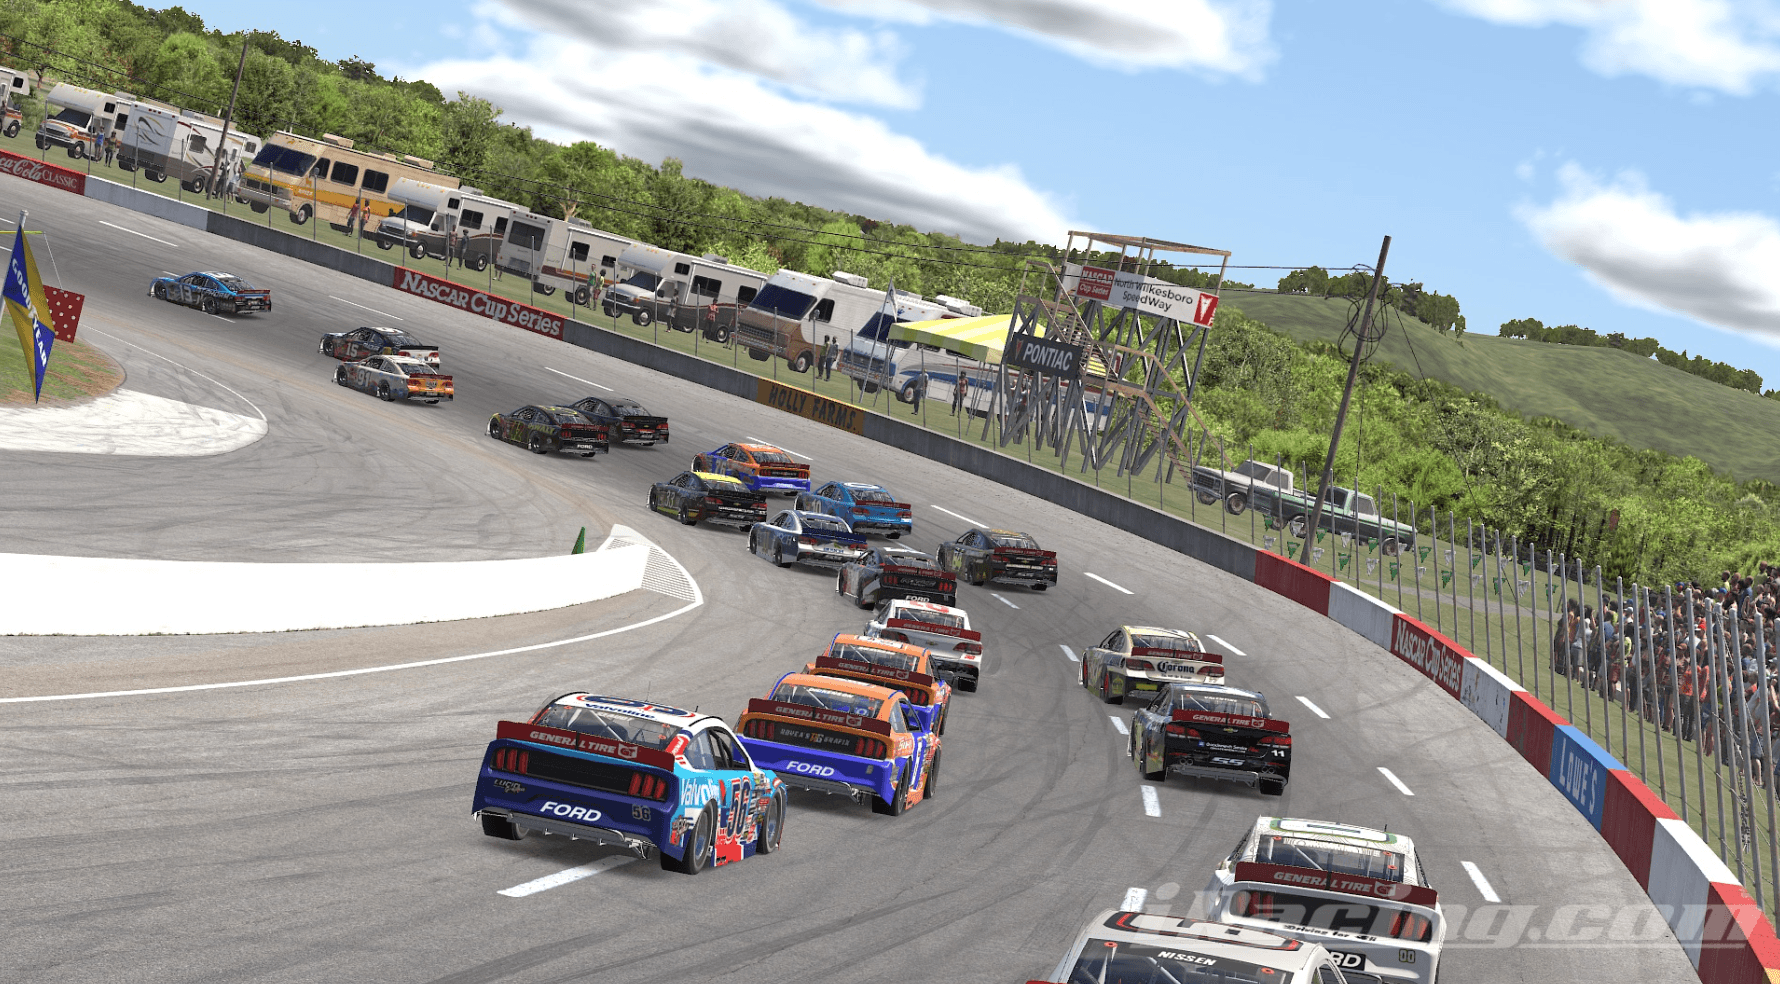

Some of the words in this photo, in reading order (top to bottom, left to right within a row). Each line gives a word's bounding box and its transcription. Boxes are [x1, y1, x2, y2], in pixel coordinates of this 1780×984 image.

[43, 169, 77, 188] CLASSIC
[1122, 291, 1171, 312] SpeedWay
[1135, 281, 1193, 305] Wilkesboro
[400, 270, 469, 308] NASCAR
[470, 293, 507, 321] Cup
[508, 303, 561, 336] Series
[345, 342, 359, 358] 15
[1023, 342, 1073, 371] PONTIAC
[358, 368, 372, 388] 91
[768, 385, 807, 413] HOLLY
[906, 595, 930, 603] FORD
[1395, 619, 1426, 668] NASCAR
[1425, 636, 1441, 682] Cup
[1439, 644, 1462, 693] Series
[1157, 661, 1195, 674] Corona
[585, 703, 655, 719] Valvoline
[775, 706, 821, 719] GENERAL
[822, 713, 846, 724] TIRE
[1192, 714, 1231, 724] GENERAL
[1231, 718, 1251, 726] TIRE
[529, 730, 587, 749] GENERAL
[588, 741, 617, 754] TIRE
[1271, 749, 1286, 758] 11
[785, 760, 835, 778] FORD
[1558, 737, 1598, 816] LOWE'S
[540, 801, 602, 822] FORD
[632, 804, 652, 821] 56
[726, 775, 752, 839] 56
[1273, 871, 1338, 889] GENERAL
[1340, 880, 1373, 892] TIRE
[1332, 931, 1350, 939] for
[1157, 951, 1217, 966] NISSEN
[1330, 951, 1362, 968] RD
[1399, 949, 1415, 964] 00
